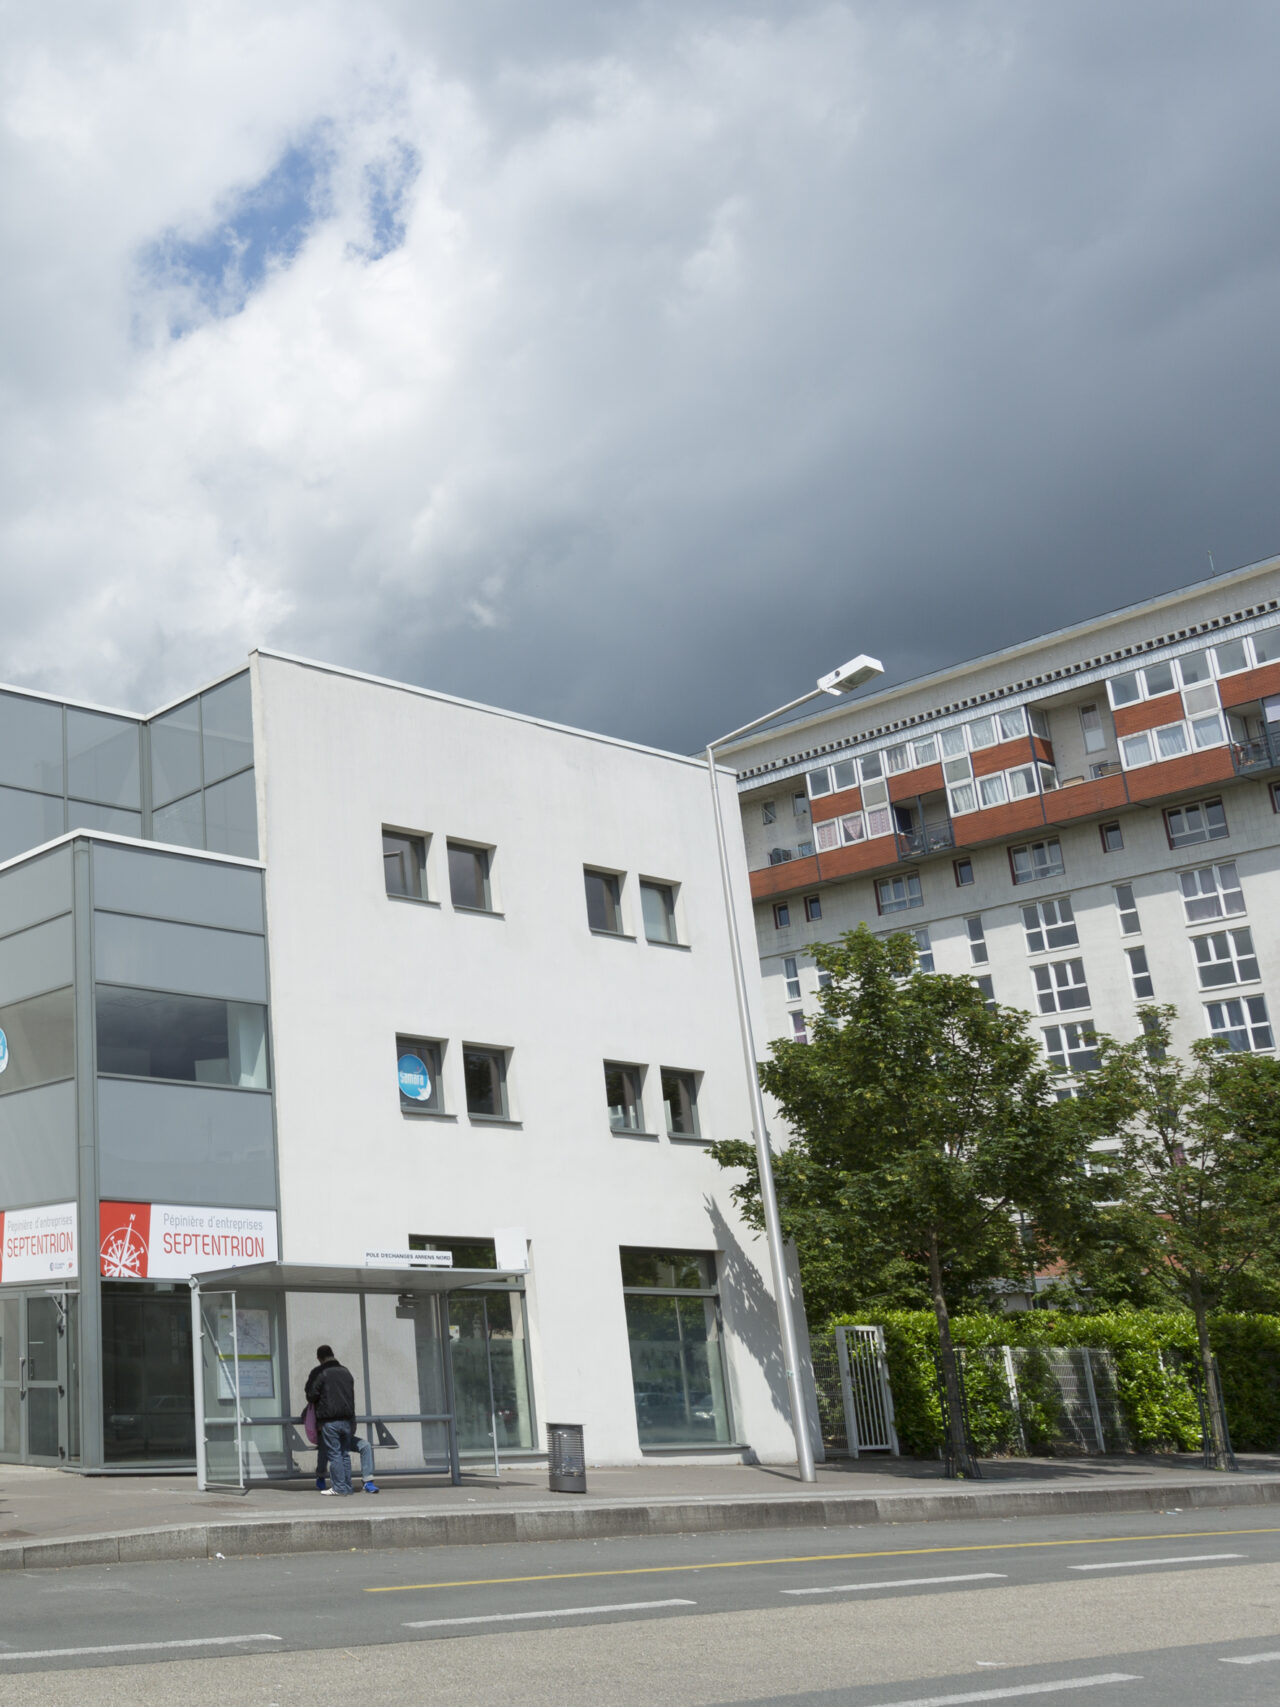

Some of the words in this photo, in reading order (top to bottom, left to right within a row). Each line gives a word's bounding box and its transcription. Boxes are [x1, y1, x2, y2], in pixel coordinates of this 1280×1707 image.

[163, 1213, 204, 1230] Pépinière
[208, 1216, 263, 1232] d'entreprises
[7, 1231, 74, 1258] SEPTENTRION
[163, 1232, 265, 1258] SEPTENTRION
